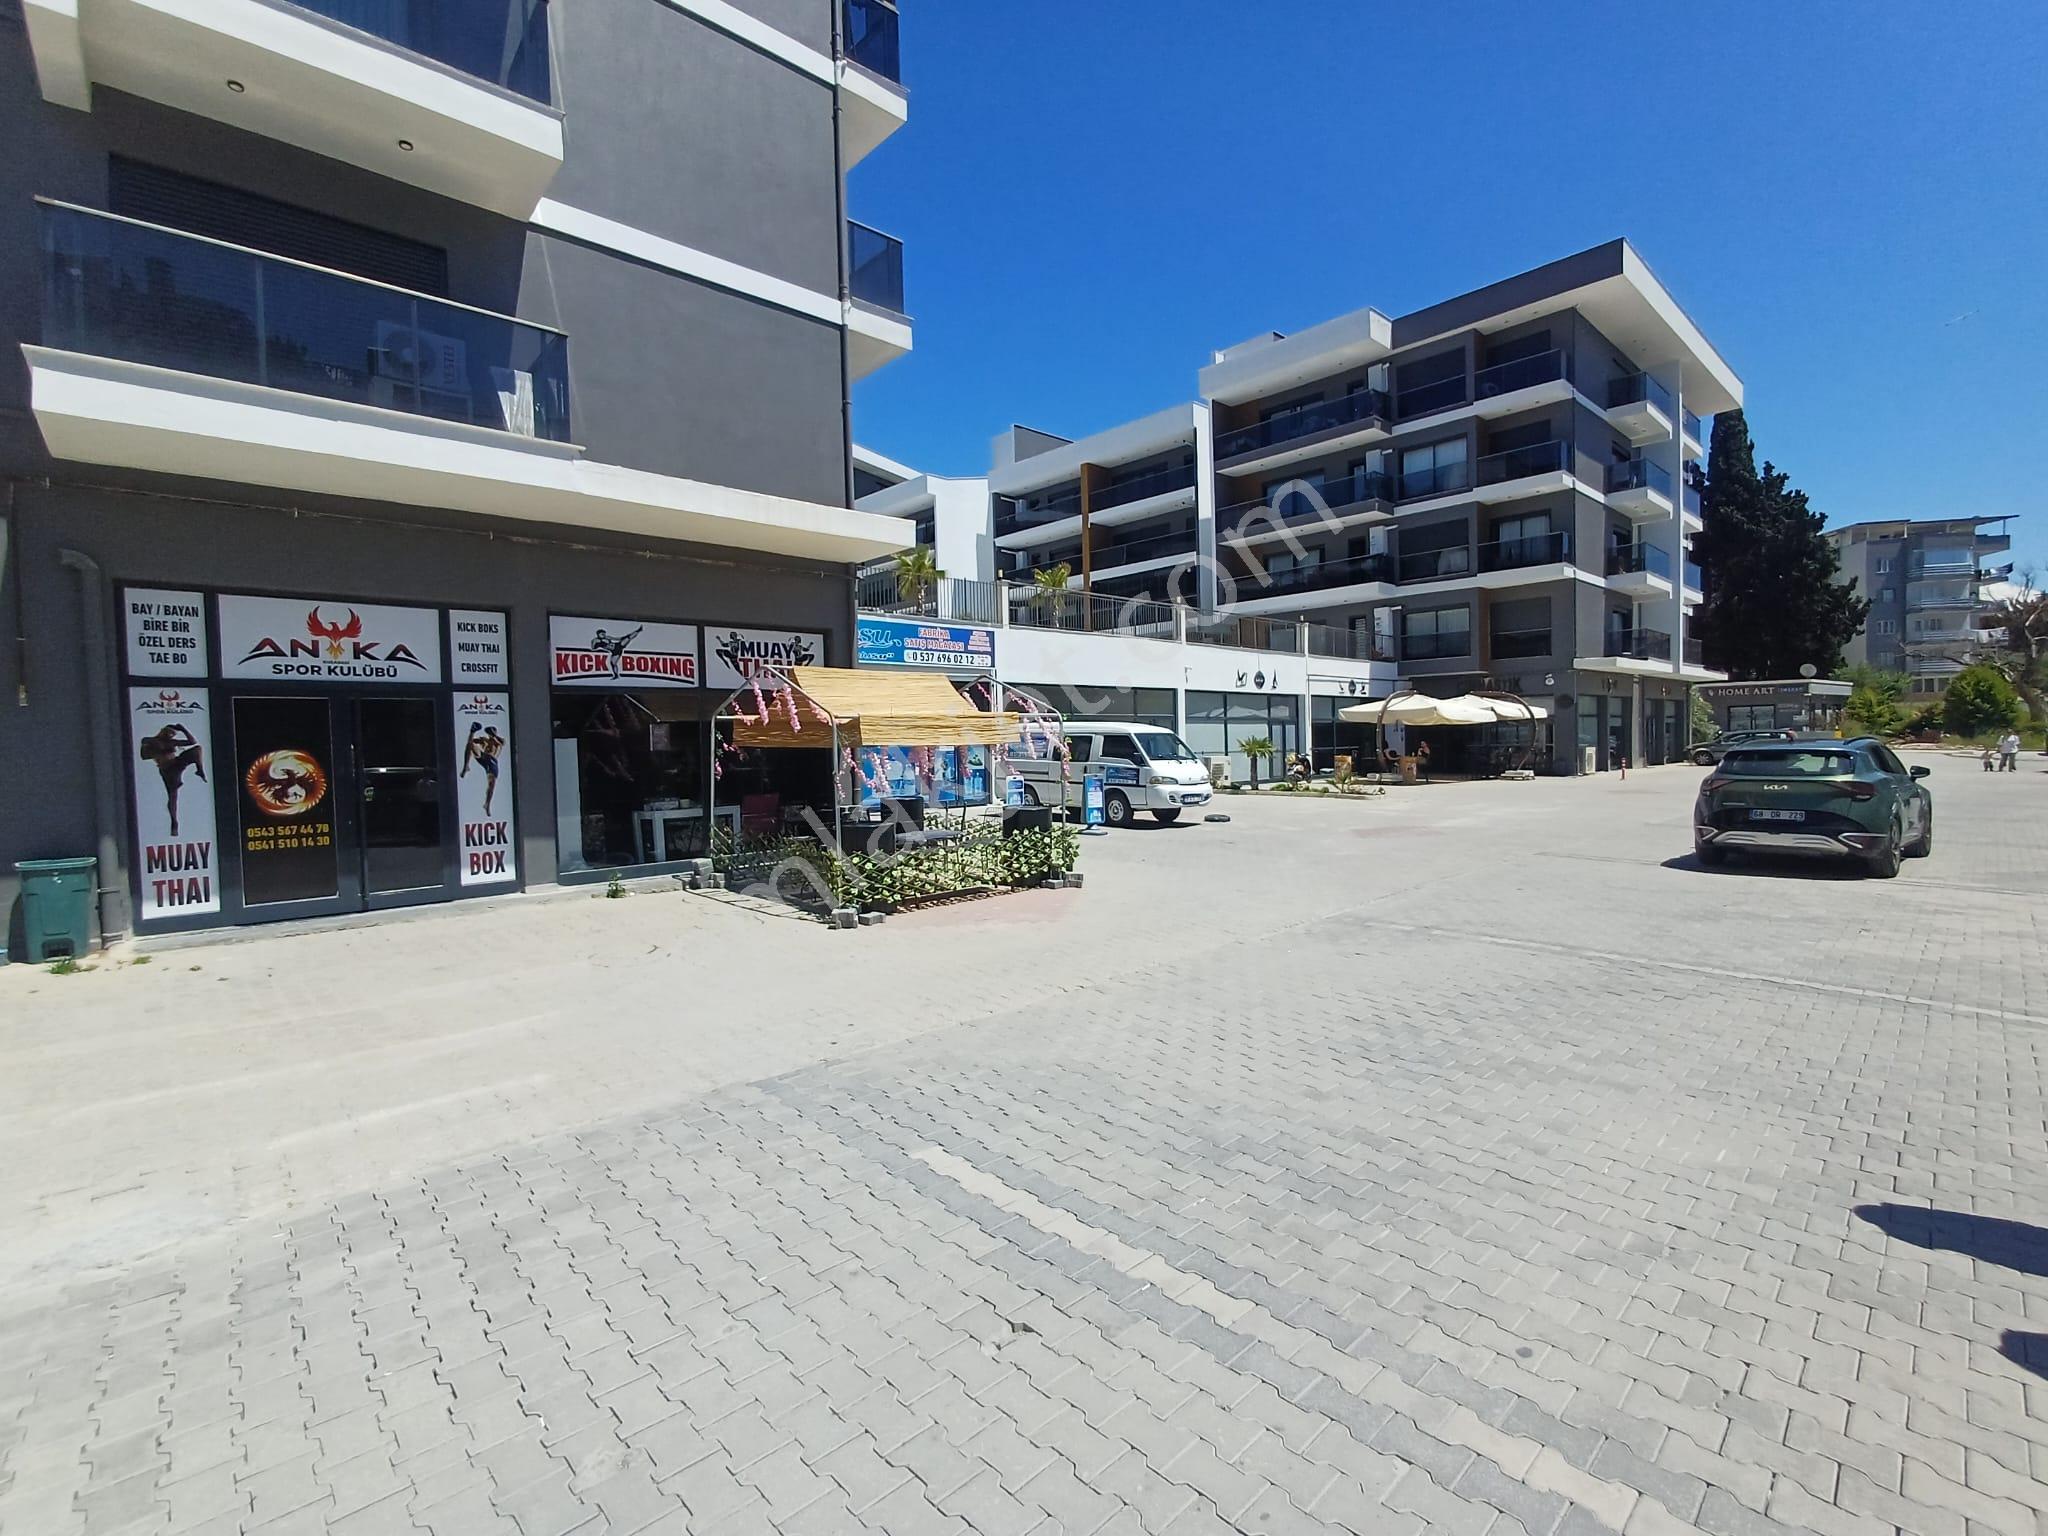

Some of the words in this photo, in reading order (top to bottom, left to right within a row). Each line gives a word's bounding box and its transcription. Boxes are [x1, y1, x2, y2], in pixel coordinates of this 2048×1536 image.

[131, 603, 153, 615] BAY
[163, 605, 199, 617] BAYAN
[143, 617, 169, 632] BİRE
[171, 618, 190, 633] BİR
[457, 621, 476, 633] KICK
[478, 623, 499, 633] BOKS
[138, 633, 165, 648] ÖZEL
[168, 637, 196, 649] DERS
[458, 642, 480, 653] MUAY
[481, 643, 500, 653] THAI
[740, 640, 795, 659] MUAY
[149, 652, 170, 664] TAE
[172, 652, 187, 664] BO
[920, 652, 935, 662] 537
[937, 653, 952, 663] 696
[953, 655, 963, 664] 02
[966, 655, 975, 665] 12
[271, 663, 322, 676] SPOR
[327, 664, 398, 678] KULÜBÜ
[461, 662, 498, 673] CROSSFIT
[555, 653, 609, 675] KICK
[621, 655, 695, 679] BOXING
[1718, 688, 1750, 697] HOME
[1753, 687, 1775, 696] ART
[247, 826, 275, 838] 0543
[277, 825, 298, 836] 567
[300, 824, 314, 834] 44
[464, 821, 508, 847] KICK
[247, 839, 275, 851] 0541
[278, 838, 299, 849] 510
[301, 837, 314, 847] 14
[145, 842, 211, 874] MUAY
[469, 850, 506, 876] BOX
[152, 876, 211, 908] THAI
